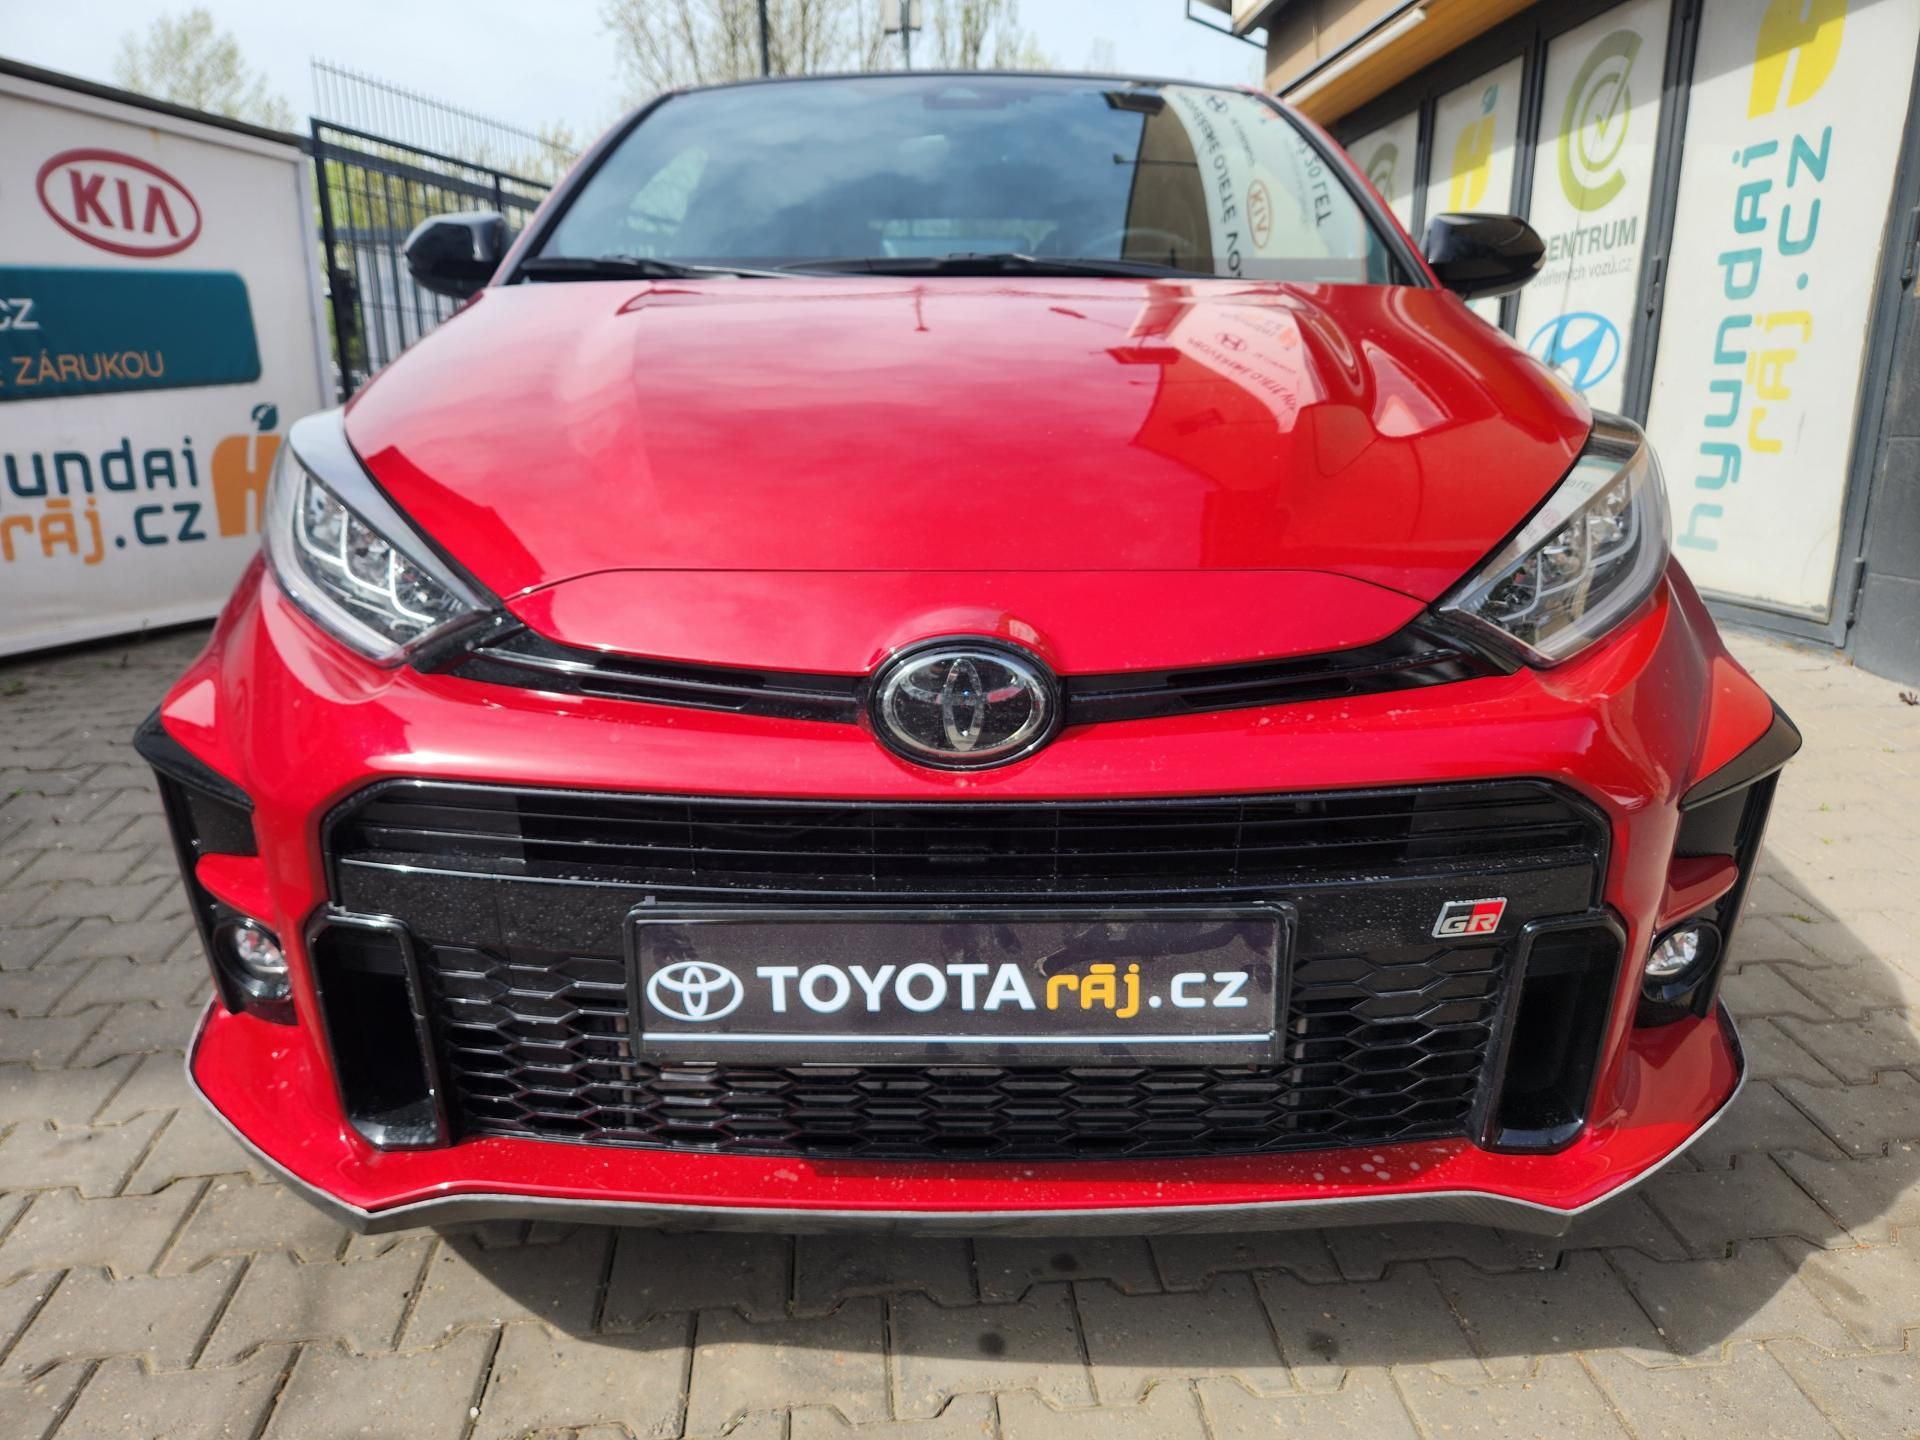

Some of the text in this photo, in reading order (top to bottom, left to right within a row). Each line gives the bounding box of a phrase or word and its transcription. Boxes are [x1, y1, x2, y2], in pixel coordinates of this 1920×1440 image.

[68, 169, 180, 238] KIA
[1543, 216, 1637, 262] ENTRUM
[11, 349, 165, 386] ZÁRUKOU
[1440, 913, 1497, 934] GR
